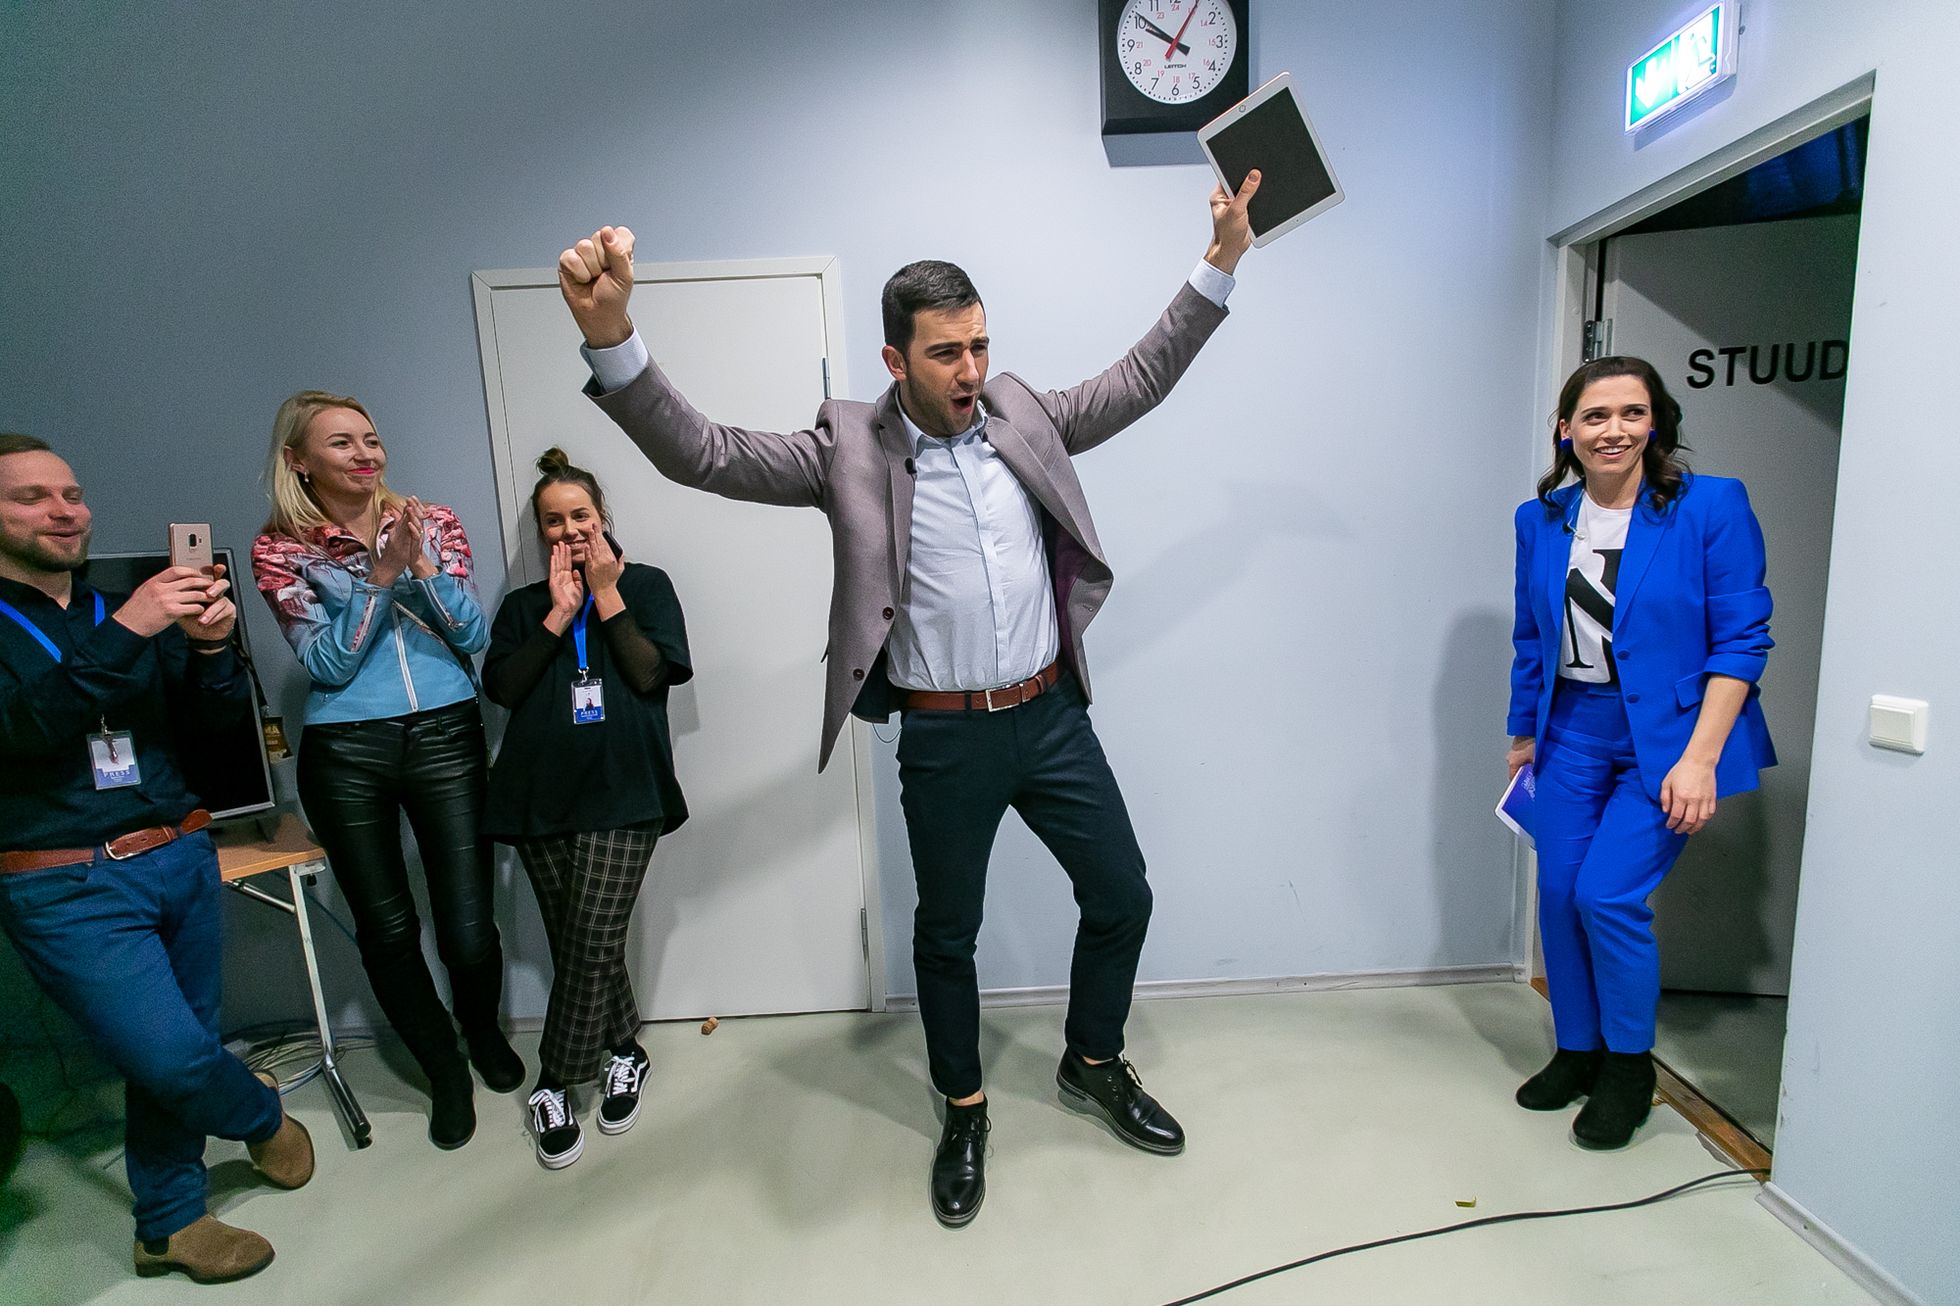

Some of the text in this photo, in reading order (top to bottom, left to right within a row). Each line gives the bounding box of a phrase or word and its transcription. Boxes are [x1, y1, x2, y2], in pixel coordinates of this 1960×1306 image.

[1134, 14, 1147, 30] 10
[1156, 11, 1165, 20] 23
[1208, 11, 1217, 25] 2
[1127, 39, 1136, 53] 9
[1136, 41, 1144, 49] 21
[1208, 39, 1216, 47] 15
[1215, 34, 1224, 49] 3
[1134, 61, 1143, 75] 8
[1143, 59, 1152, 67] 20
[1208, 60, 1217, 72] 4
[1151, 77, 1159, 91] 7
[1171, 83, 1180, 96] 6
[1192, 76, 1201, 90] 5
